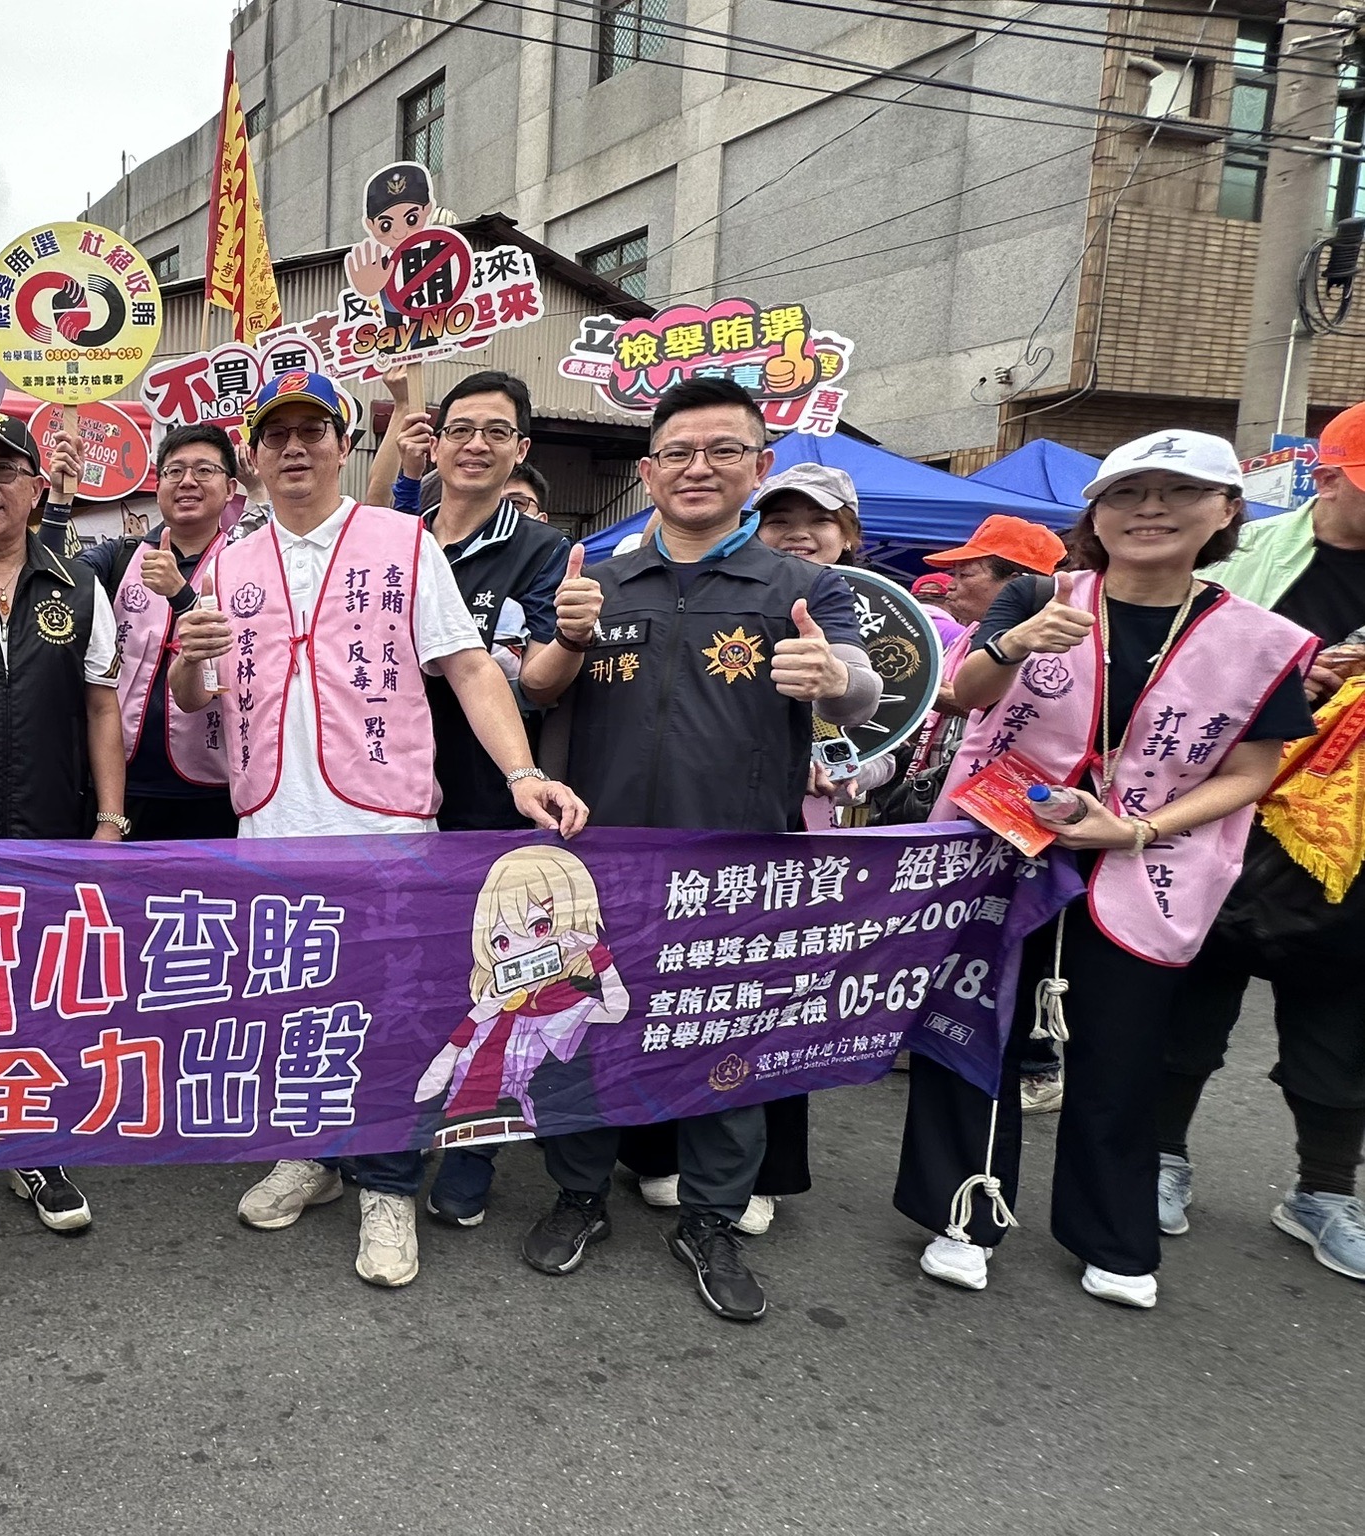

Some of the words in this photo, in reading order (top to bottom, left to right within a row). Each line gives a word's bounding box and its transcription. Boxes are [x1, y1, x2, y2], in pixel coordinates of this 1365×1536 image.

[79, 230, 156, 326] 杜絕收賄
[400, 240, 453, 309] 賄
[354, 322, 417, 354] Say
[419, 302, 475, 341] NO
[617, 305, 804, 370] 檢舉賄選
[3, 351, 42, 361] 檢舉電話
[44, 349, 143, 361] 0800-024-099
[22, 375, 124, 387] 臺灣雲林地方檢察署
[201, 396, 244, 419] NO!
[588, 652, 640, 683] 刑警
[364, 695, 389, 765] 一點通
[645, 968, 836, 1018] 查賄反賄一點通
[755, 1031, 903, 1073] 臺灣雲林地方檢察署
[930, 1015, 970, 1043] 廣告
